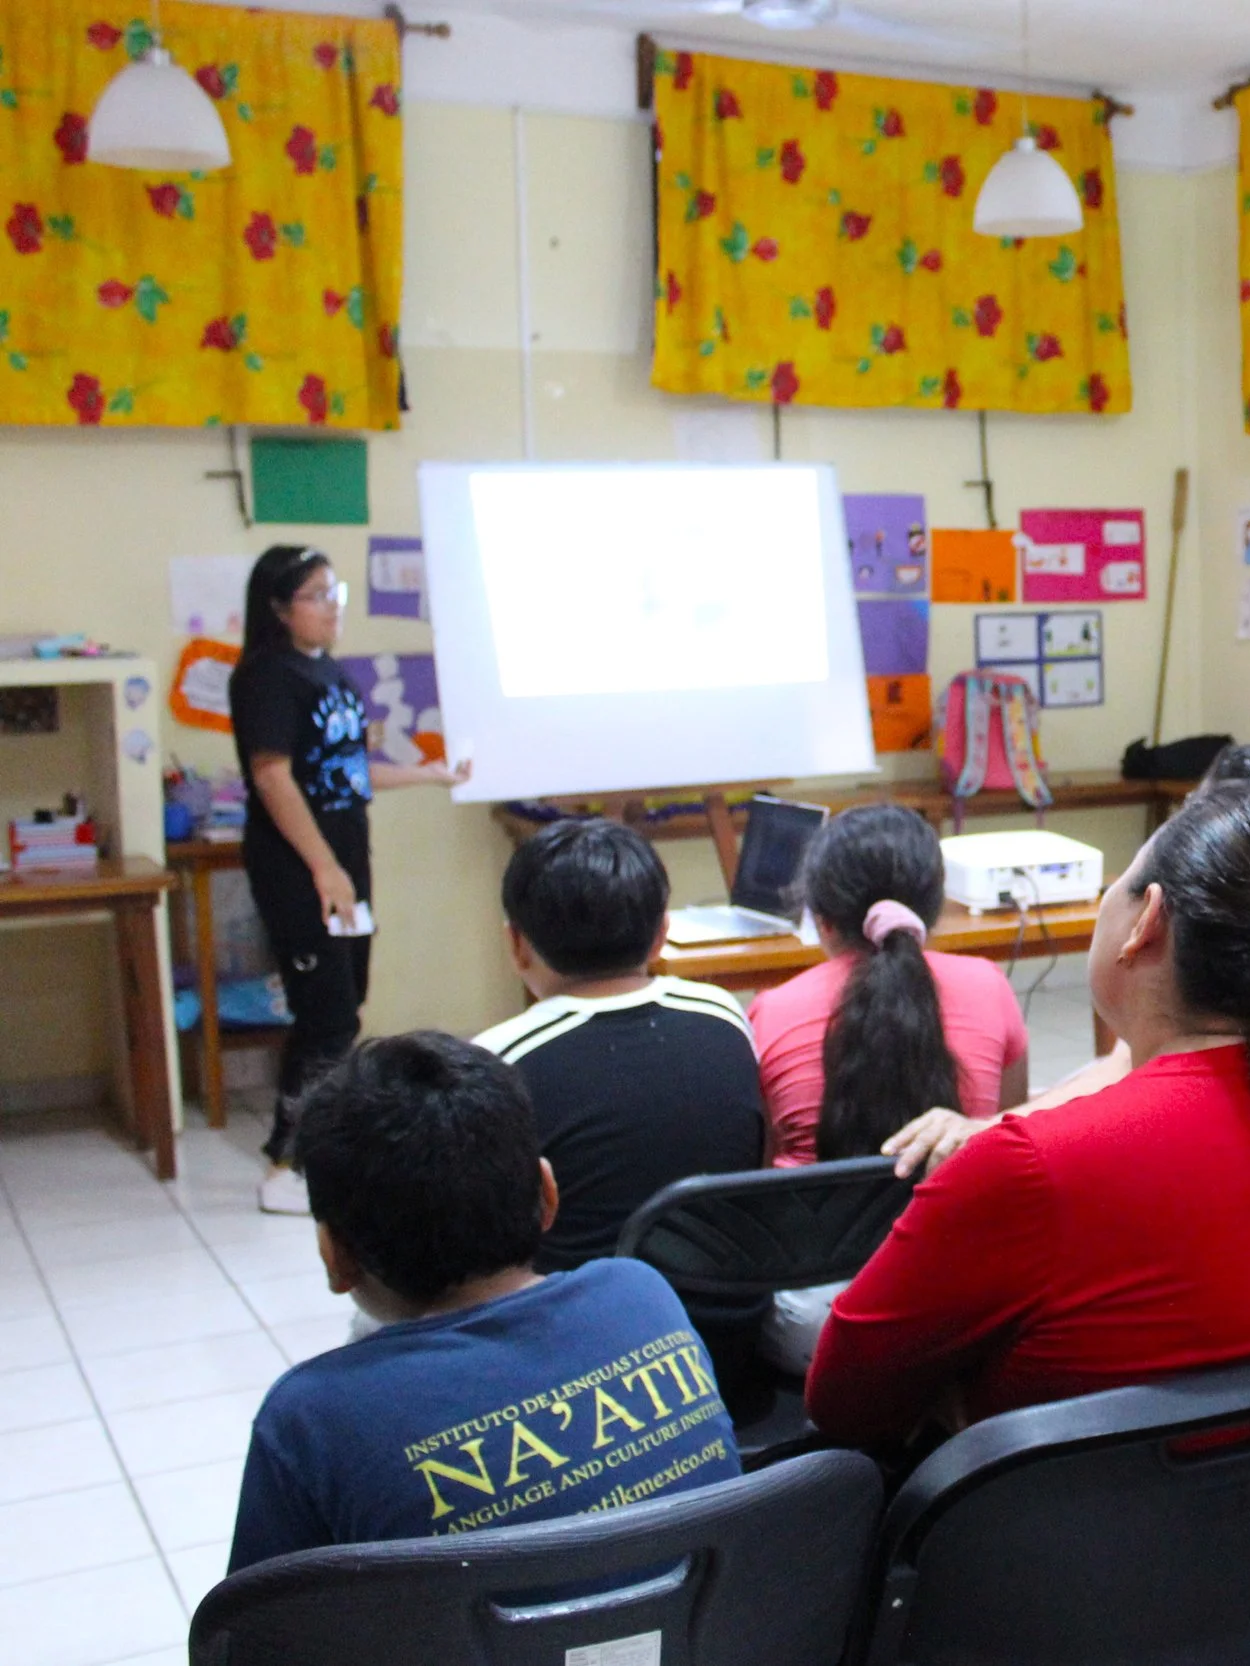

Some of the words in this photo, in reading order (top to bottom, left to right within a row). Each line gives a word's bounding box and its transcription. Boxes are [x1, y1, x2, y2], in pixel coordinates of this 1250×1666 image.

[404, 1405, 519, 1462] INSTITUTO
[521, 1392, 551, 1415] DE
[551, 1356, 632, 1401] LENGUAS
[629, 1350, 643, 1365] Y
[560, 1459, 604, 1491] AND
[605, 1422, 681, 1468] CULTURE
